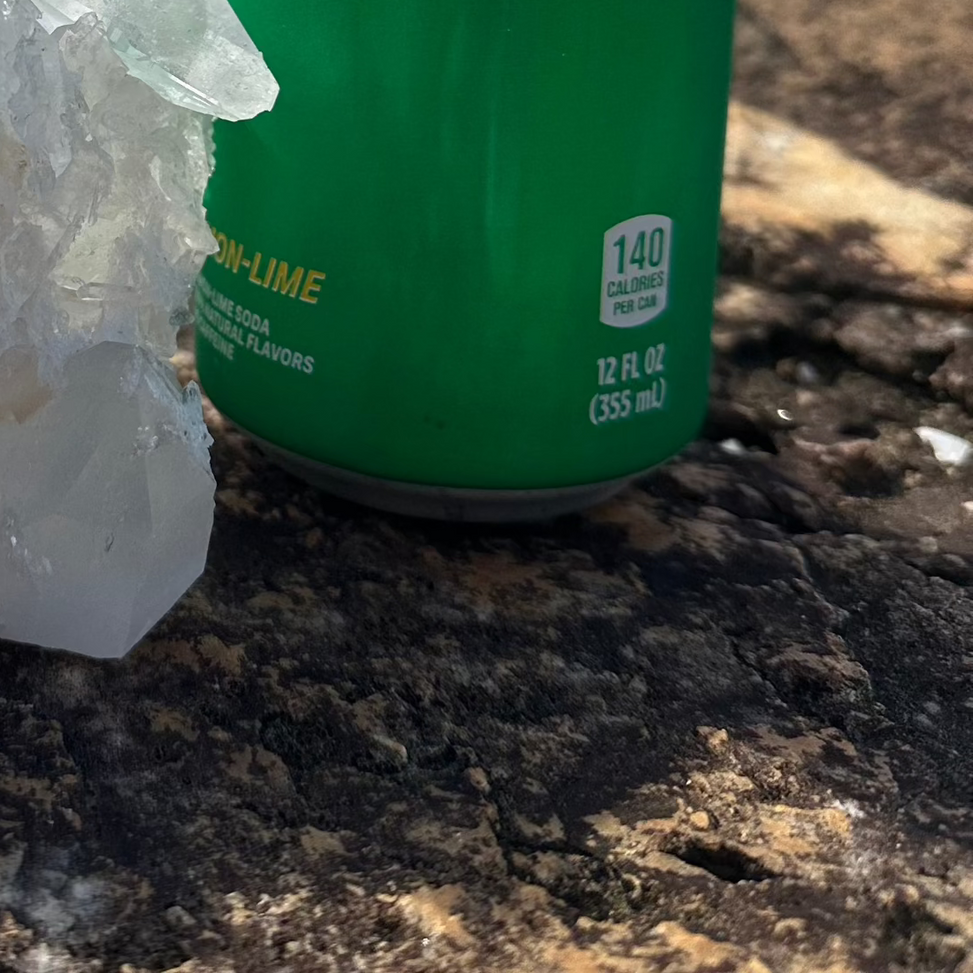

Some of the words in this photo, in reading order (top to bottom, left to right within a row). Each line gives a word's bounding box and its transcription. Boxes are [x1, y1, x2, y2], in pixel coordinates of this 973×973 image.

[212, 227, 326, 304] ON-LIME
[613, 227, 665, 274] 140
[607, 270, 664, 298] CALORIES
[235, 305, 270, 336] SODA
[613, 300, 634, 316] PER
[638, 294, 657, 311] CAN
[246, 333, 315, 374] FLAVORS
[596, 356, 617, 385] 12
[621, 351, 639, 381] FL
[644, 343, 666, 375] OZ
[589, 389, 631, 425] (355
[635, 377, 666, 413] mL)
